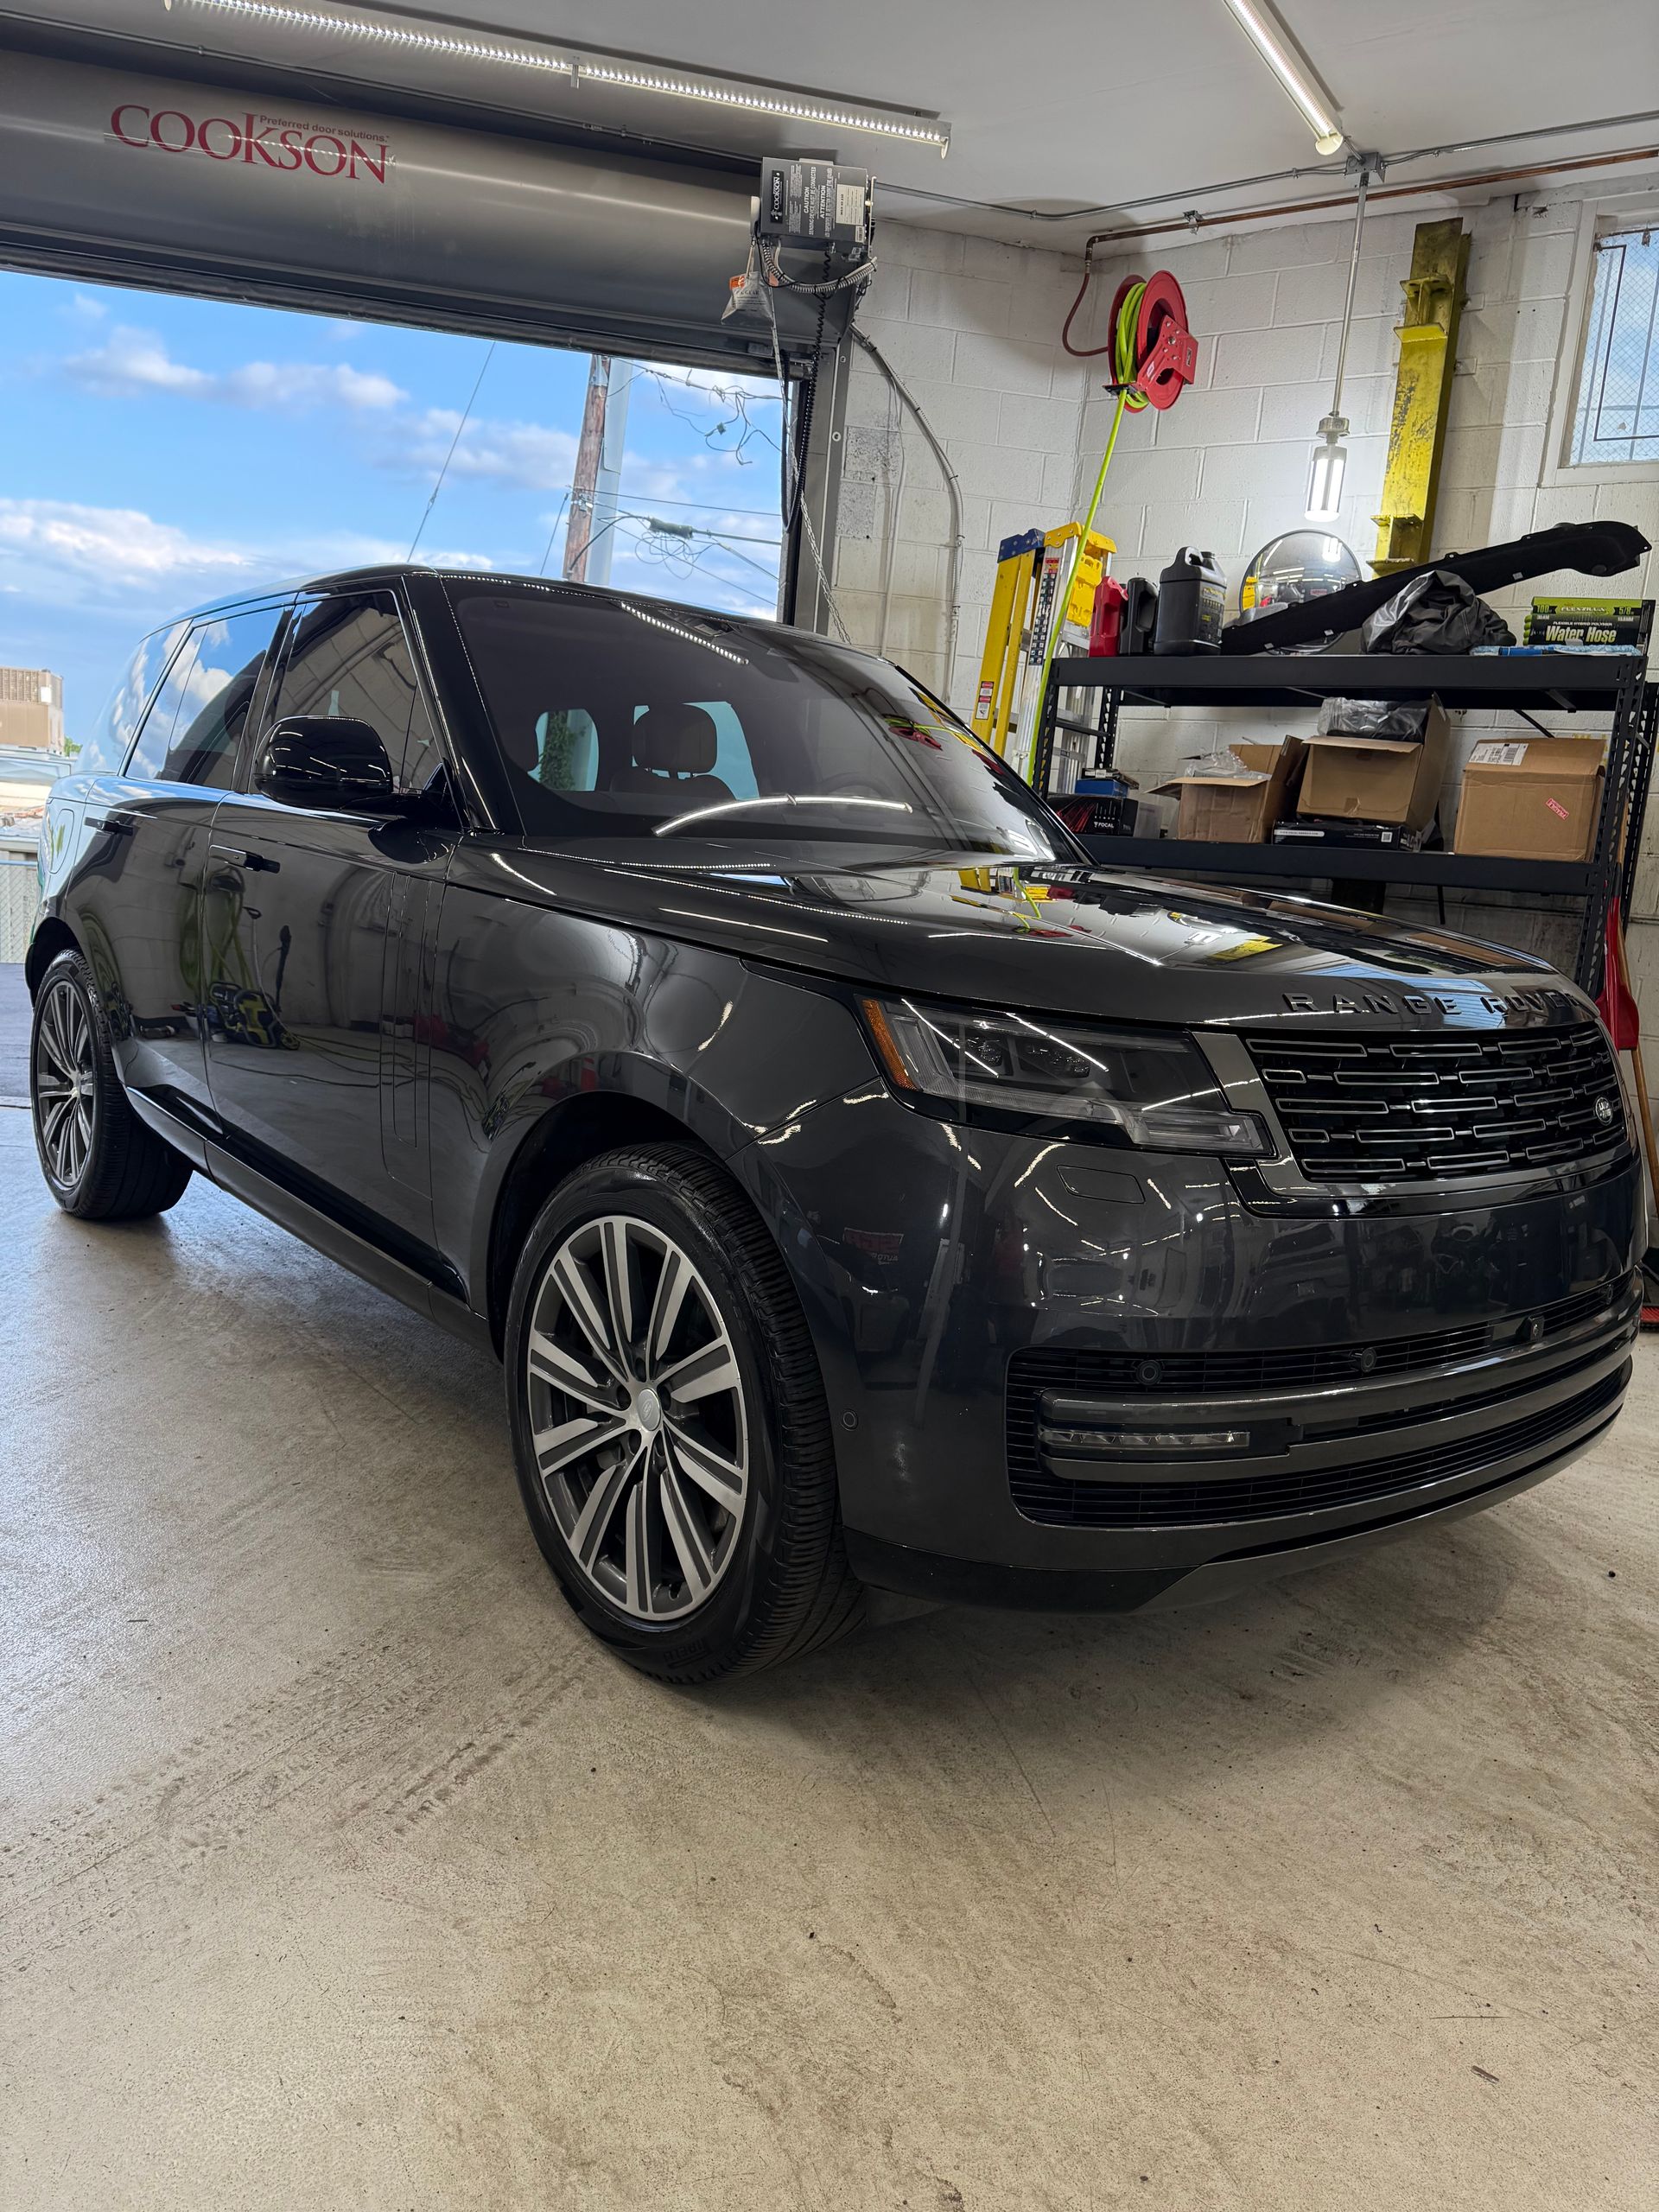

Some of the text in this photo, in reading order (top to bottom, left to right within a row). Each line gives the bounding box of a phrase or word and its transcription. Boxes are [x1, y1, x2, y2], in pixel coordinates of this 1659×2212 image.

[260, 115, 309, 130] Preferred
[312, 124, 336, 135] door
[111, 105, 390, 184] COOKSON
[1536, 605, 1549, 614] 100
[1545, 626, 1618, 644] Water Hose
[1282, 993, 1462, 1015] RANGE
